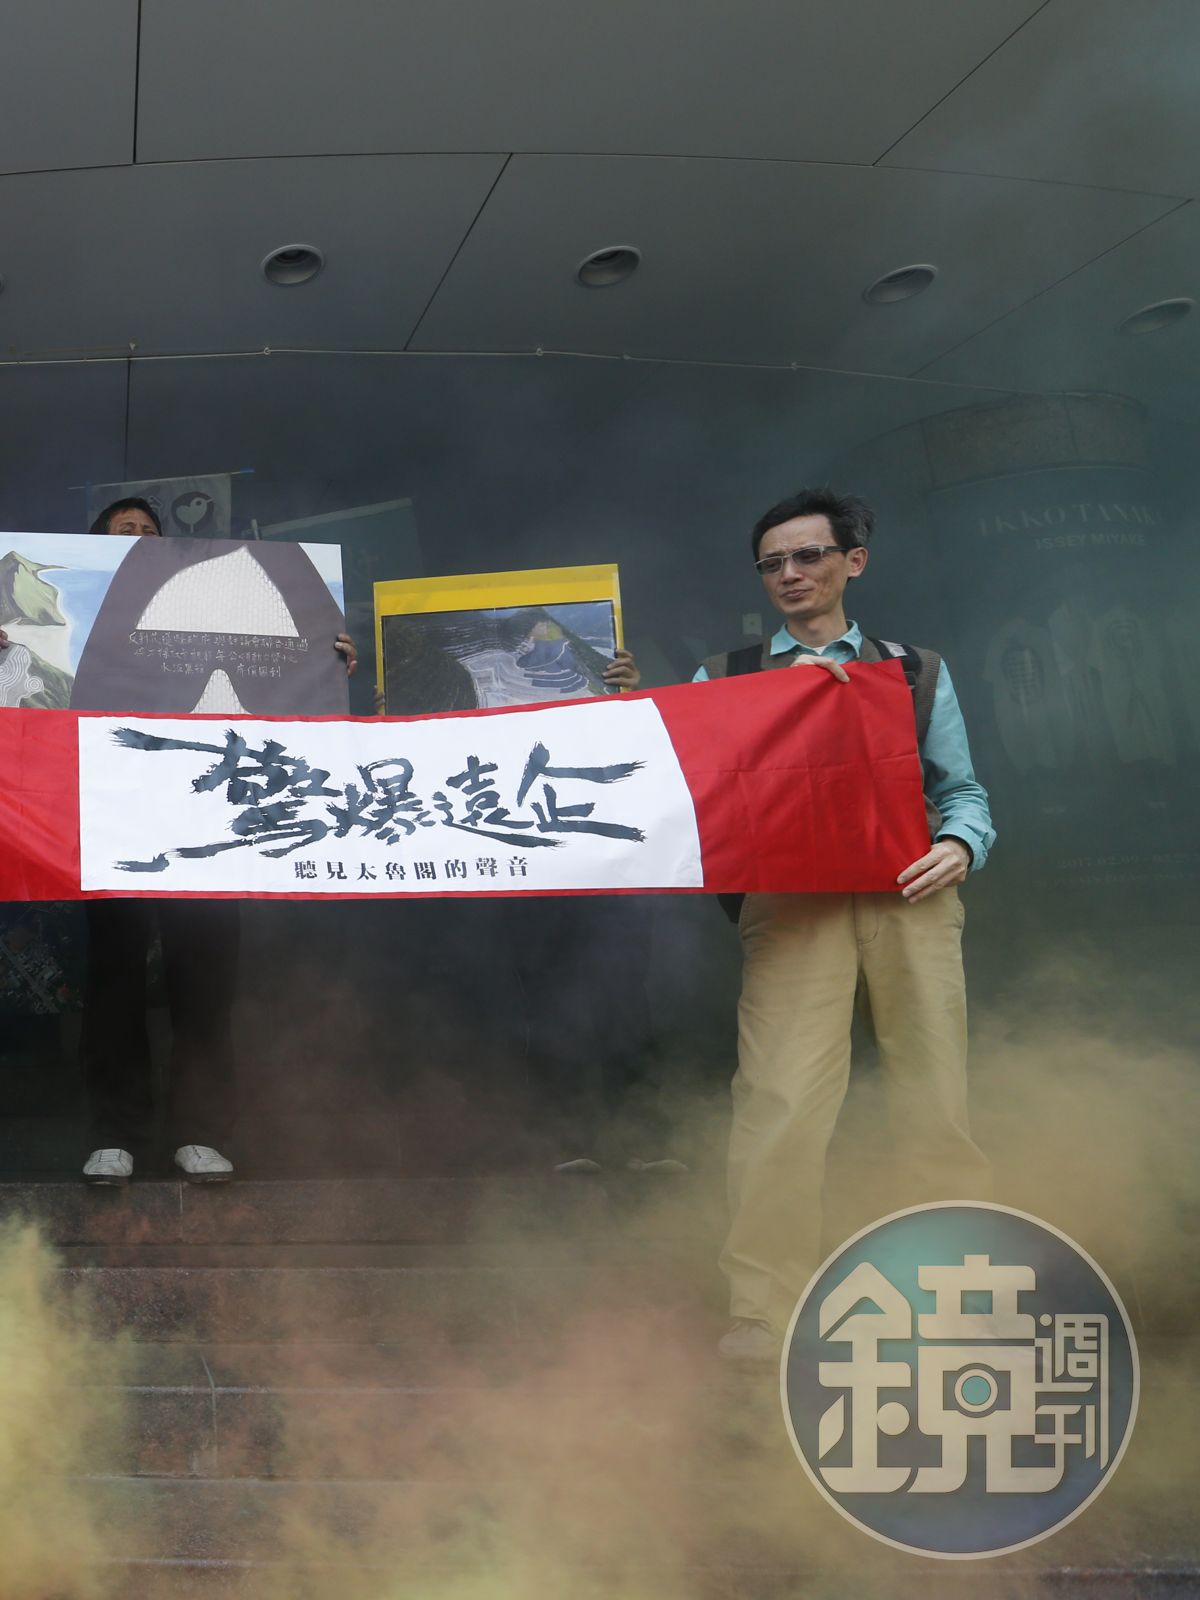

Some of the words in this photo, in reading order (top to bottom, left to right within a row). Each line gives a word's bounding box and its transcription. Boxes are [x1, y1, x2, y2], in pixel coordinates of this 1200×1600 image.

[294, 856, 529, 880] 聽見太魯閣的聲音
